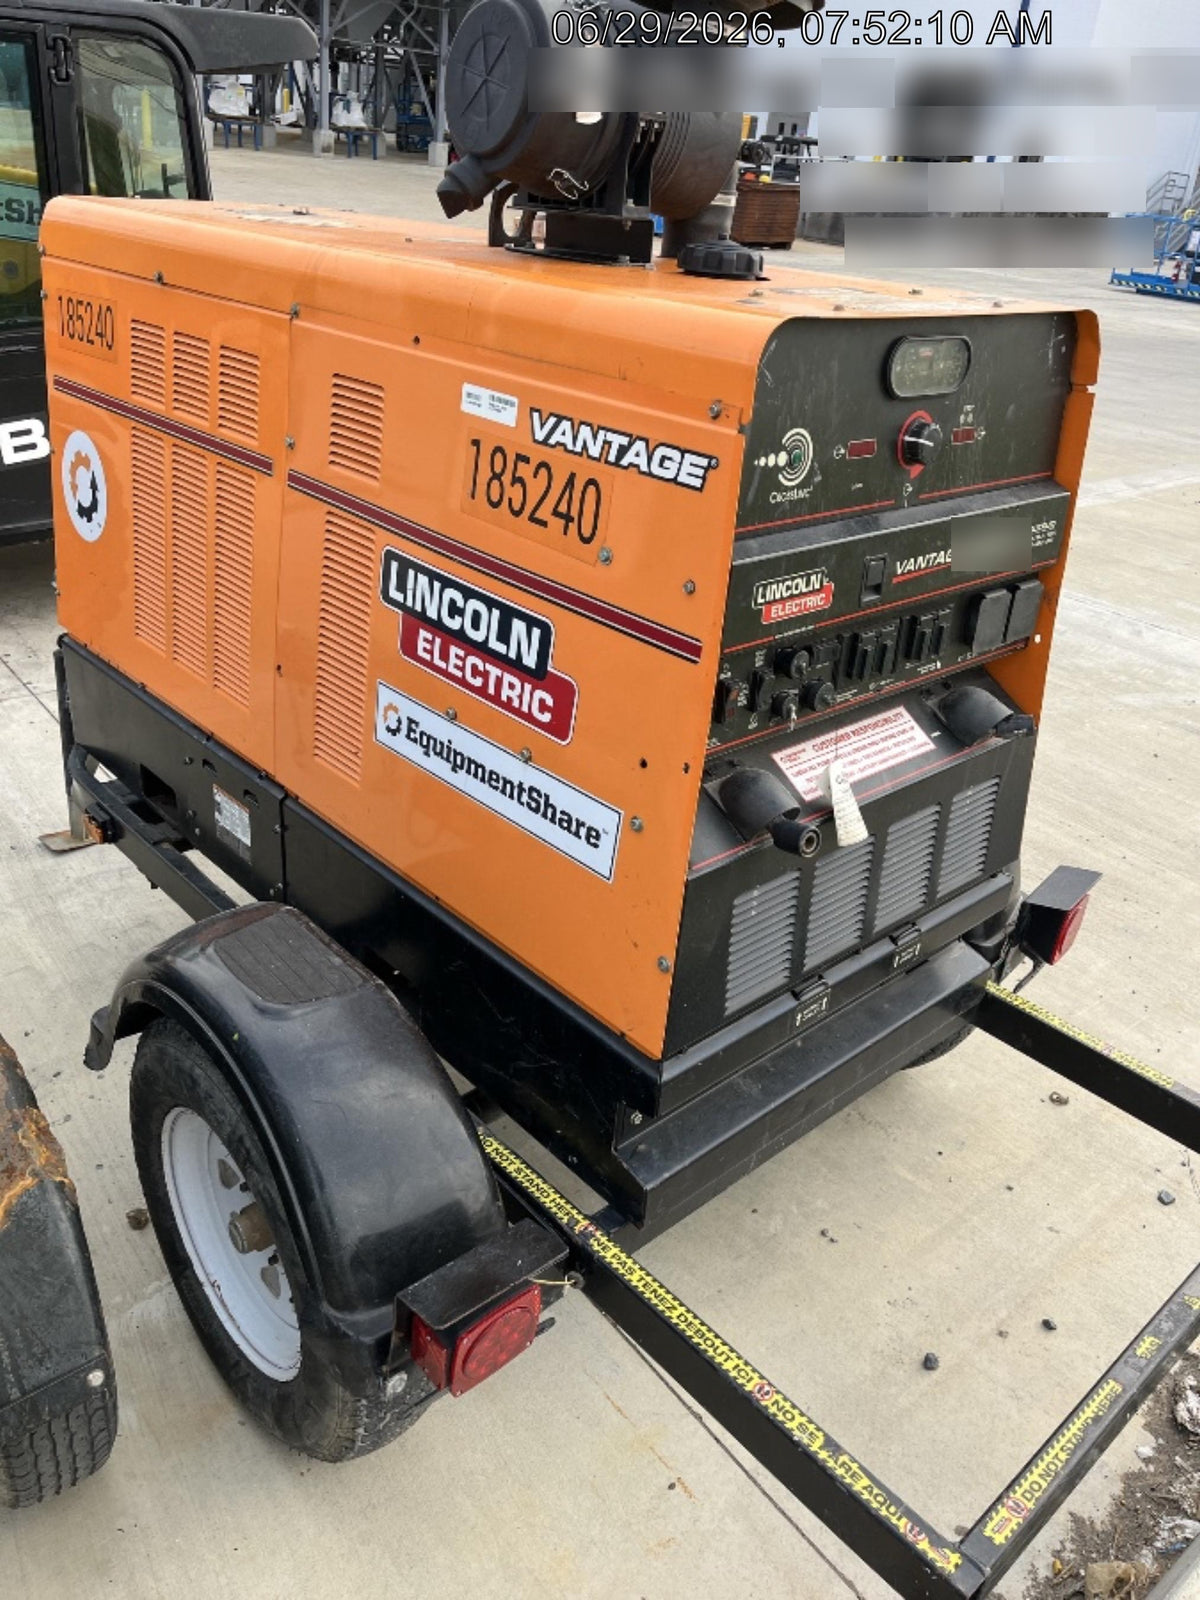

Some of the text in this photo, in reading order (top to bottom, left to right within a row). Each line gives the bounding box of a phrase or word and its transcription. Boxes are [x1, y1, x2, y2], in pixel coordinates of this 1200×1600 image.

[56, 295, 115, 351] 185240
[469, 438, 602, 545] 185240
[389, 559, 541, 670] LINCOLN
[757, 573, 822, 604] LINCOLN
[771, 593, 826, 618] ELECTRIC
[417, 628, 554, 723] ELECTRIC
[491, 1147, 517, 1166] NOT
[514, 1166, 551, 1199] STAND
[593, 1238, 754, 1384] NE PAS TENEZ DEBOUT ICI
[771, 1399, 796, 1422] NO
[796, 1422, 819, 1444] SE
[1021, 1480, 1042, 1503] DO
[1039, 1456, 1063, 1485] NOT
